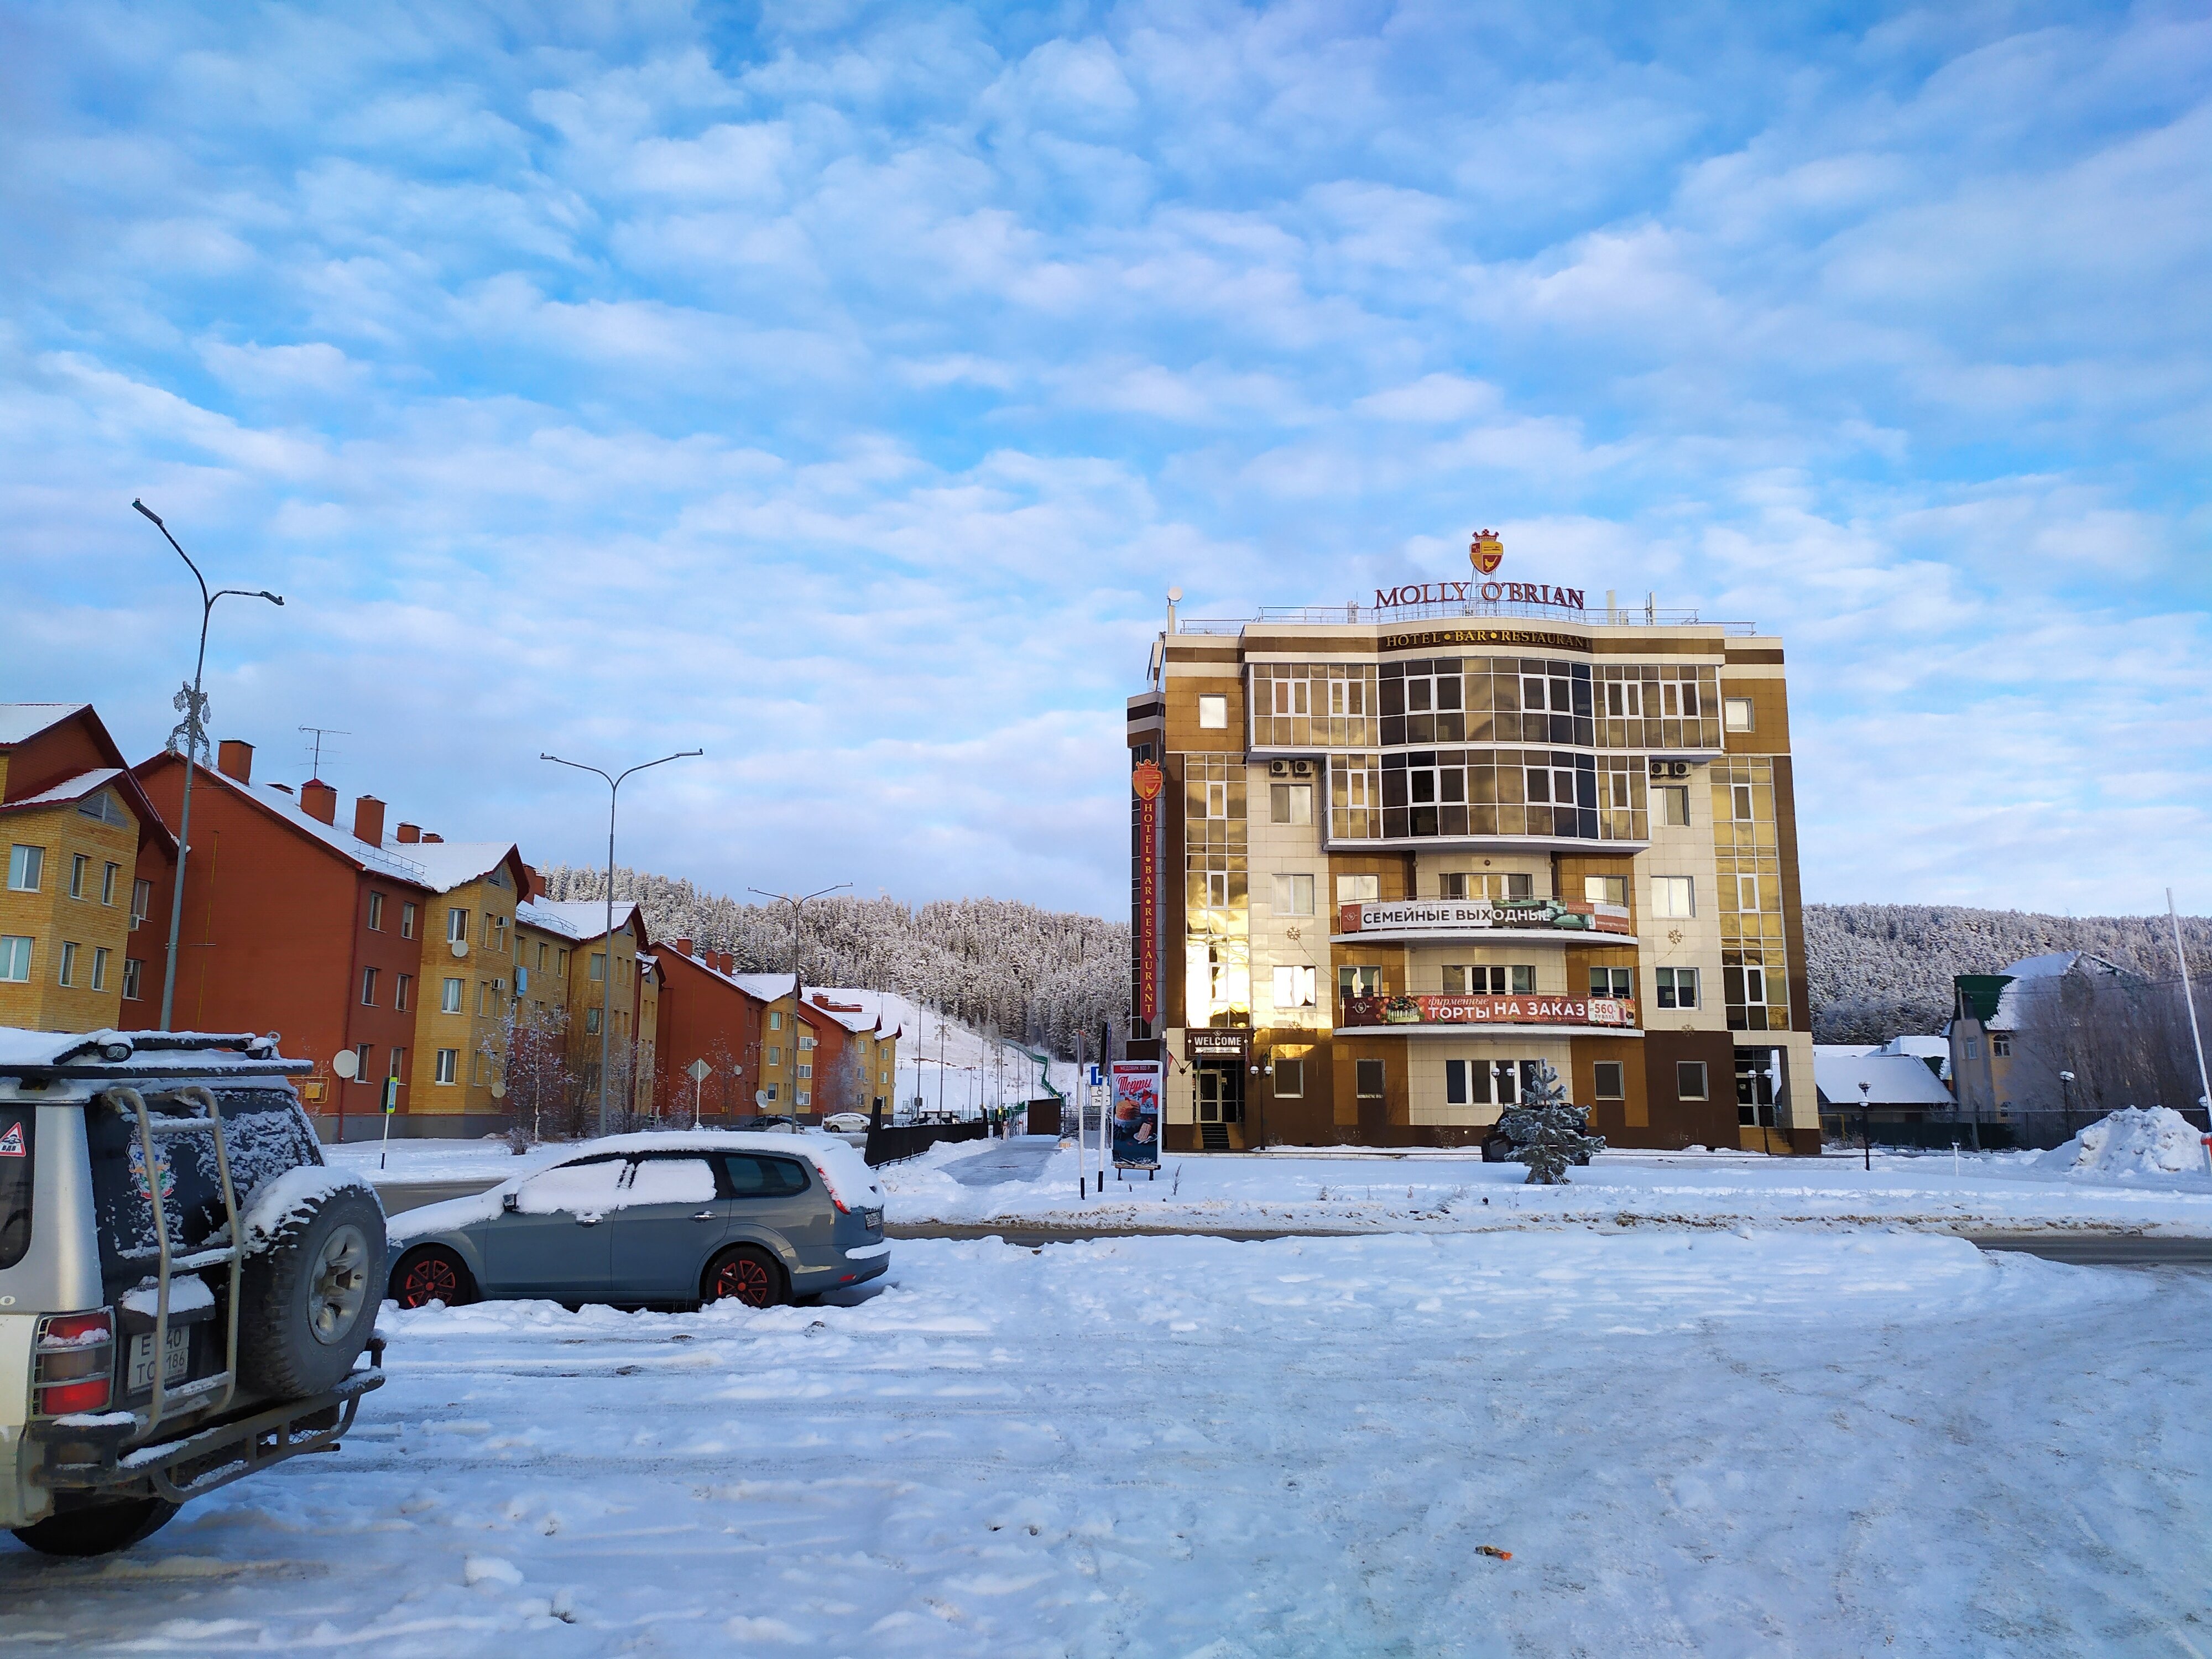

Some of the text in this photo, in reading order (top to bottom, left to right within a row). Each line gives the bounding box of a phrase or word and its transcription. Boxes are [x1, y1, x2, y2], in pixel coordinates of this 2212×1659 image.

[1374, 581, 1585, 609] MOLLY O'BRIAN
[1386, 630, 1591, 648] HOTEL BAR RESTAURANT
[1144, 804, 1153, 1013] HOTEL BAR RESTAURANT
[1363, 907, 1451, 924] СЕМЕЙНЫЕ
[1428, 997, 1489, 1007] фирменные
[1428, 1001, 1585, 1019] ТОРТЫ НА ЗАКАЗ
[1194, 1036, 1242, 1046] WELCOME
[166, 1351, 185, 1370] 186
